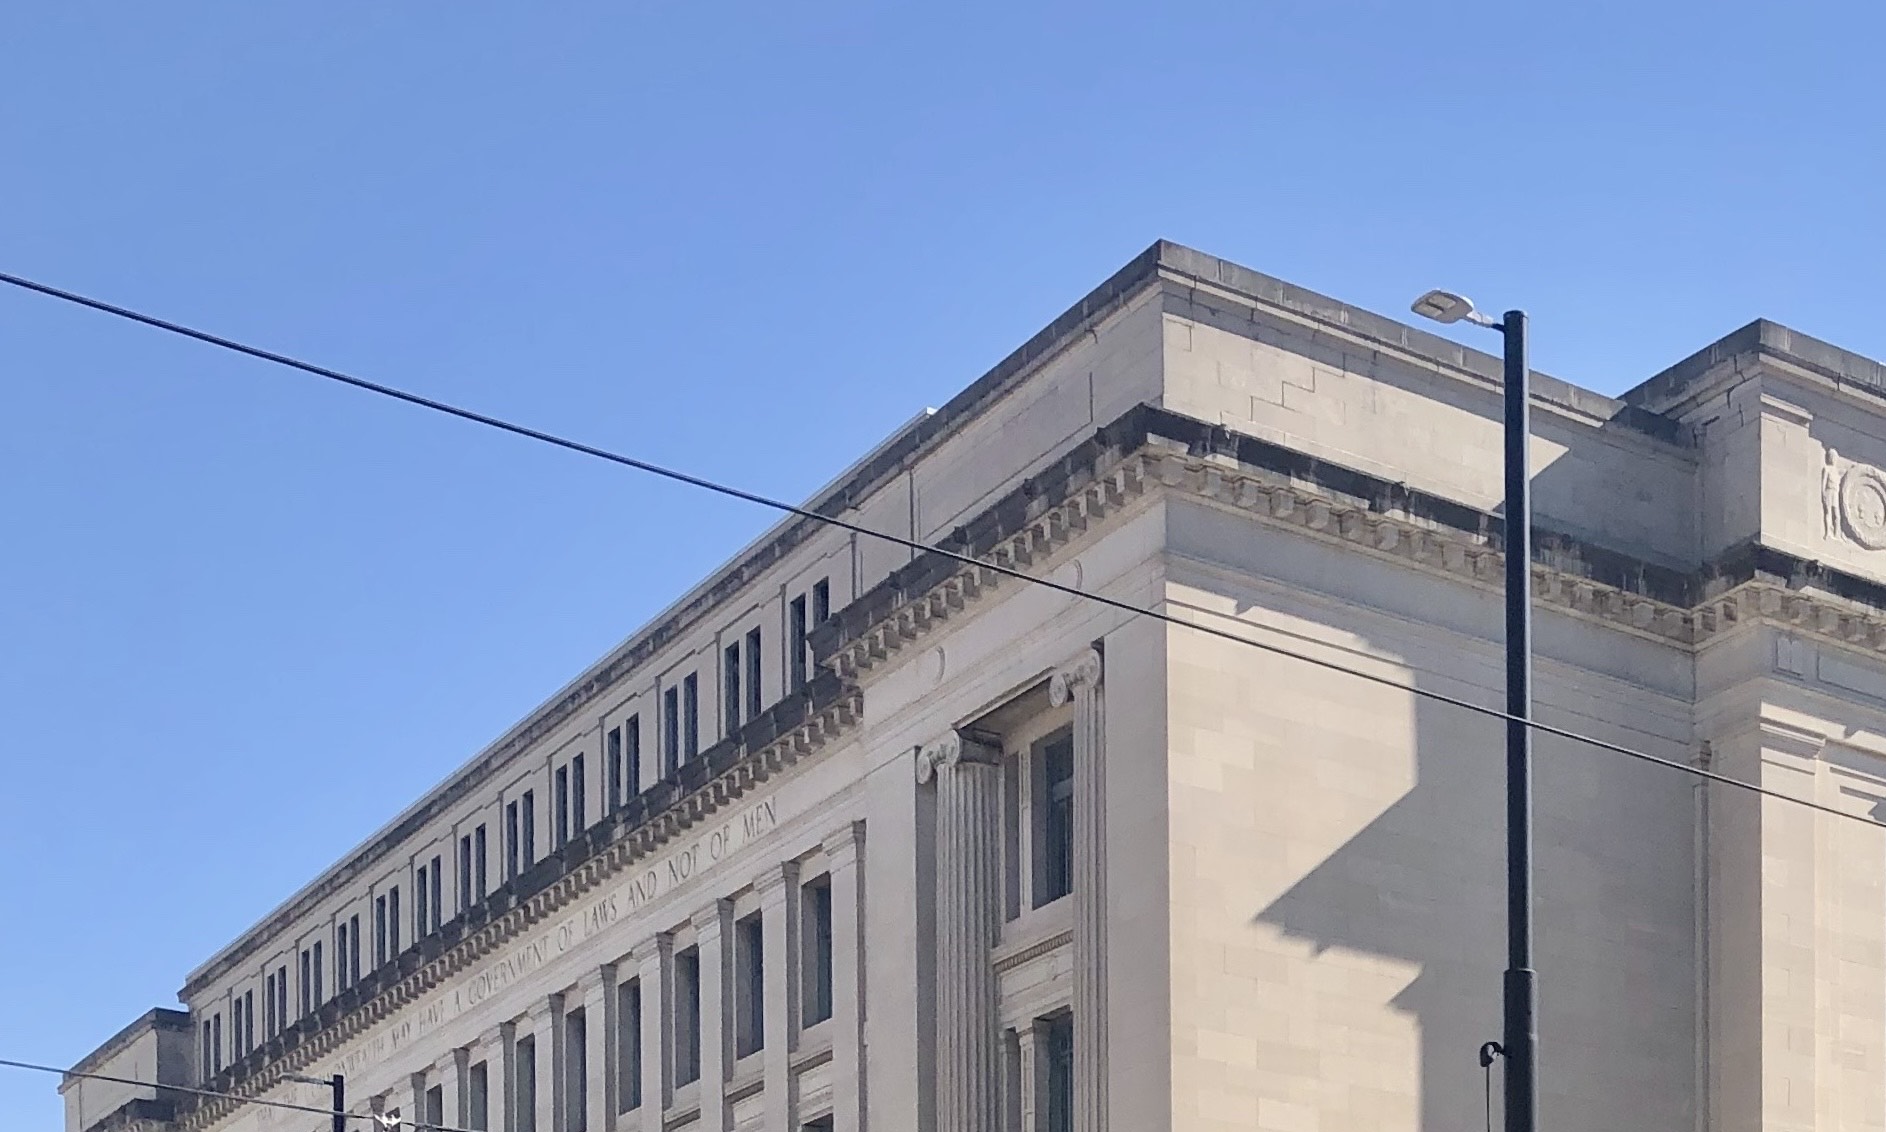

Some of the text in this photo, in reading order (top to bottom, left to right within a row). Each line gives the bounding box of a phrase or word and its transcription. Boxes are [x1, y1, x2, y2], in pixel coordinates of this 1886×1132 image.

[419, 999, 444, 1033] HAVE
[454, 990, 462, 1013] A
[468, 935, 549, 1006] GOVERNMENT
[557, 921, 573, 951] OF
[583, 893, 617, 938] LAWS
[628, 870, 657, 908] AND
[667, 844, 700, 886] NOT
[710, 824, 730, 860] OF
[742, 796, 777, 843] MEN
